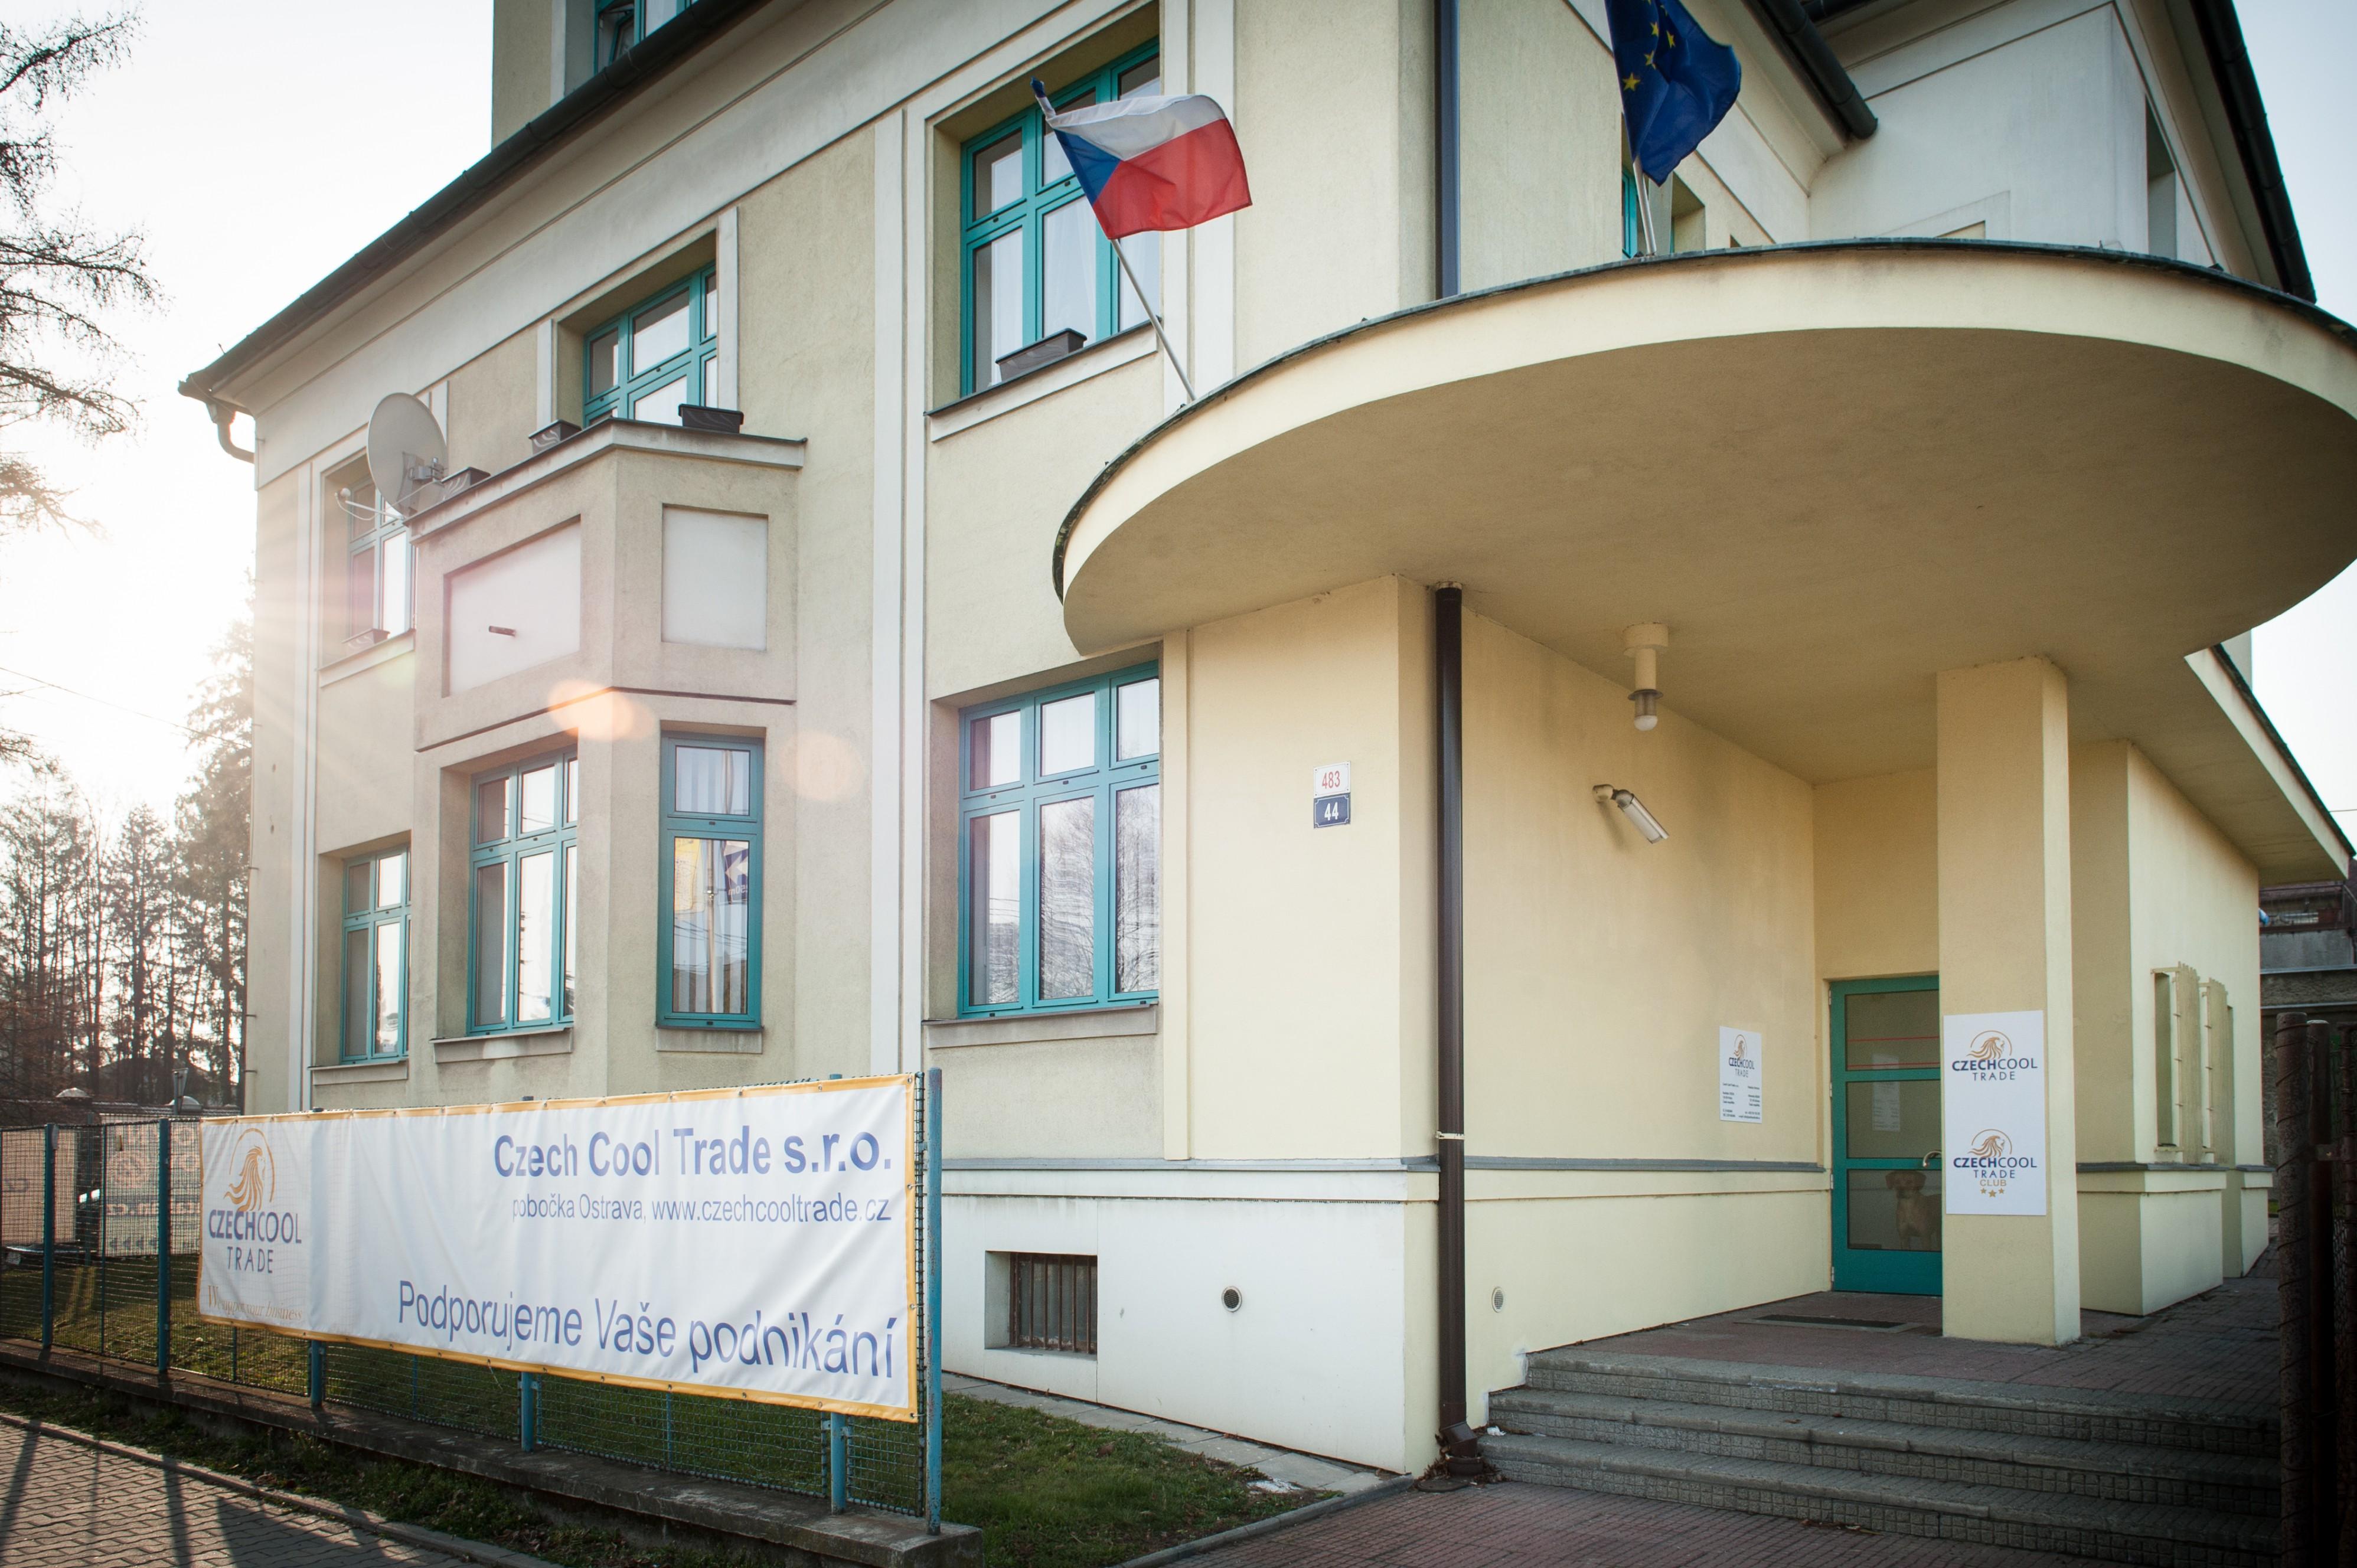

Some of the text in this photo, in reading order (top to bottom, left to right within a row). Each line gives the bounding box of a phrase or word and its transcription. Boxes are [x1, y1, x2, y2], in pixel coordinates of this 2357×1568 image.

[1322, 770, 1340, 789] 483
[1324, 802, 1339, 821] 44
[1729, 1057, 1755, 1070] CZECHCOOL
[1952, 1058, 2038, 1071] CZECHCOOL
[1735, 1069, 1748, 1078] TRADE
[1973, 1072, 2015, 1081] TRADE
[495, 1125, 891, 1177] Czech Cool Trade s.r.o.
[1953, 1157, 2038, 1168] CZECHCOOL
[1973, 1170, 2015, 1178] TRADE
[512, 1192, 892, 1224] pobočka Ostrava, www.czechcooltrade.cz
[208, 1209, 302, 1244] CZECHCOOL
[227, 1246, 273, 1273] TRADE
[265, 1301, 302, 1321] business
[399, 1280, 897, 1378] Podporujeme Vaše podnikání
